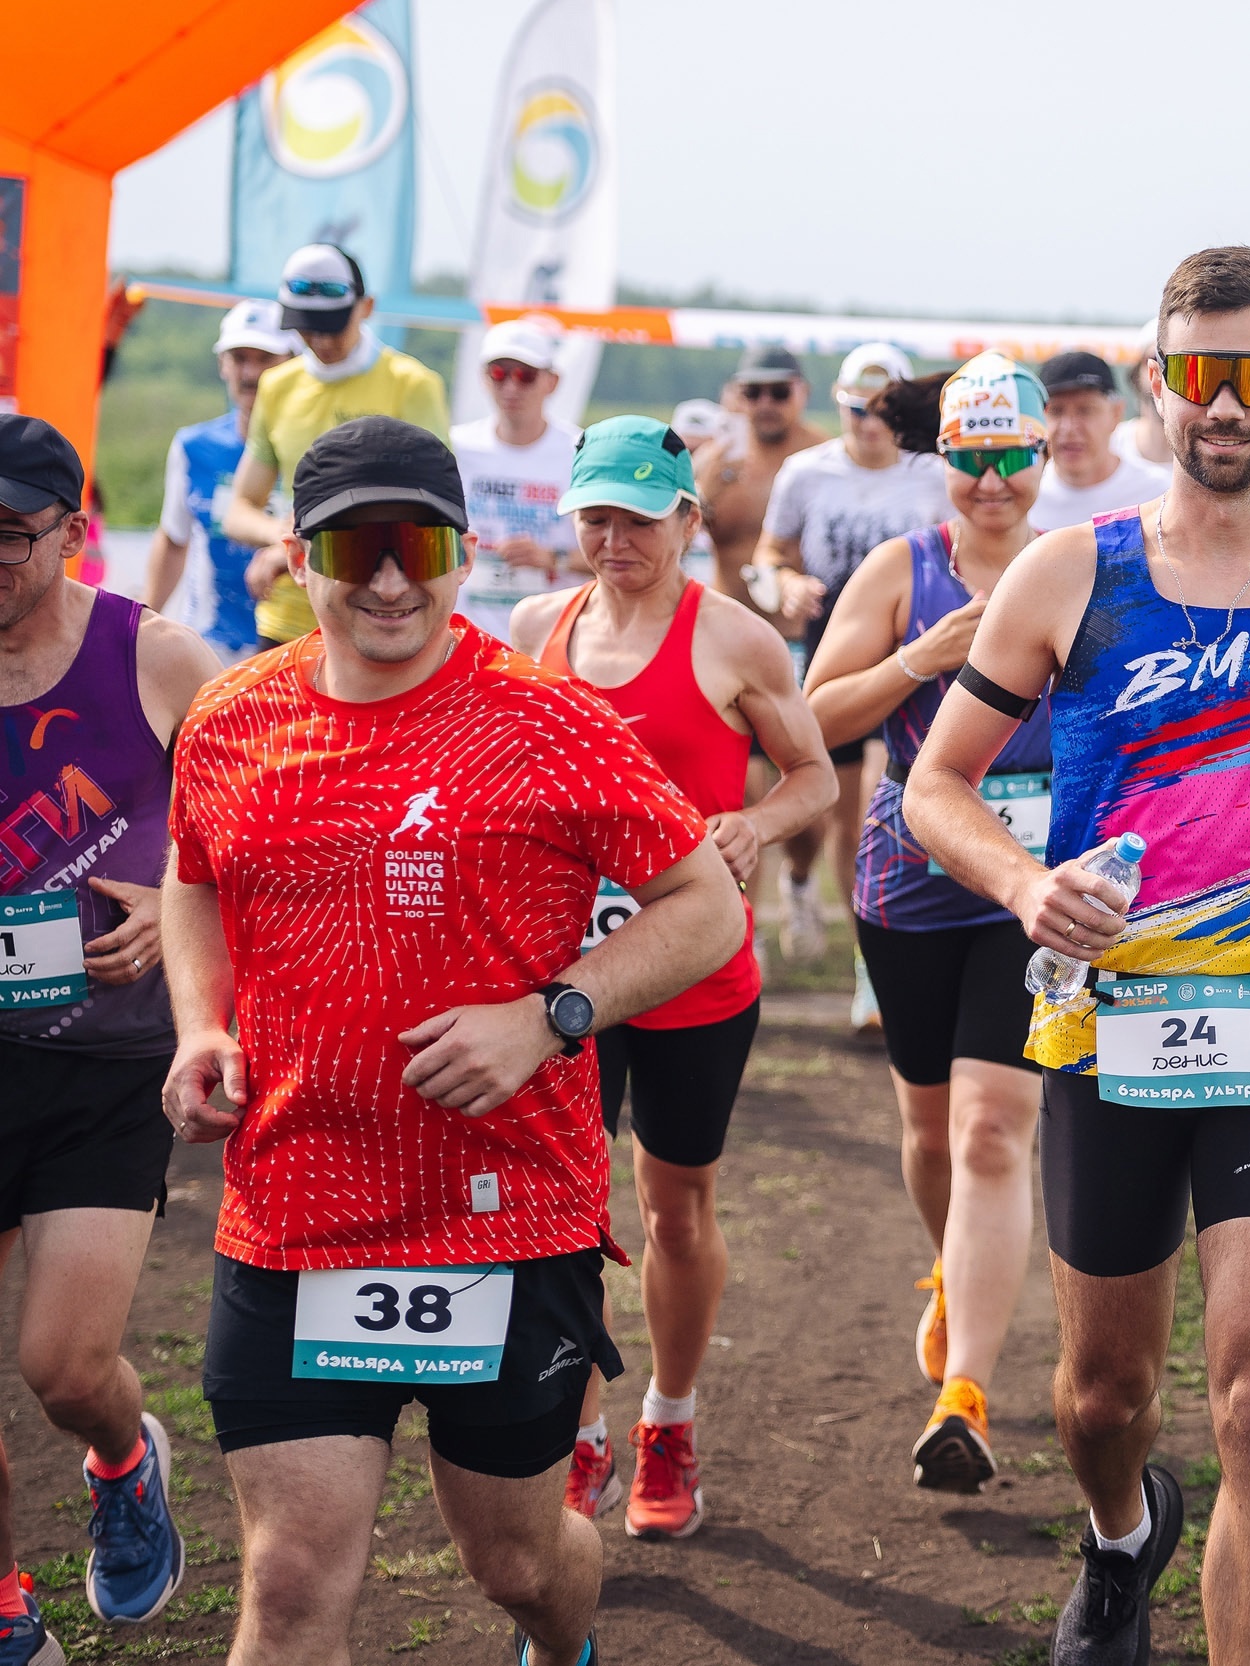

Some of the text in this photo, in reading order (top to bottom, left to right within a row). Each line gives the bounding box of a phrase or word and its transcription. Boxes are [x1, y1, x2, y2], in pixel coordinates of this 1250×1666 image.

[31, 816, 129, 896] СТИГАЙ
[385, 850, 444, 861] GOLDEN
[385, 862, 444, 878] RING
[385, 880, 444, 892] ULTRA
[385, 893, 445, 906] TRAIL
[404, 910, 425, 918] 100
[11, 985, 71, 1003] ультра
[1113, 983, 1168, 998] БАТЫР
[1161, 1015, 1217, 1048] 24
[1152, 1053, 1228, 1070] Денис
[1117, 1084, 1196, 1101] бэкъярд
[353, 1282, 453, 1334] 38
[316, 1351, 484, 1375] бэкъярд ультра
[538, 1355, 584, 1382] DEMIX
